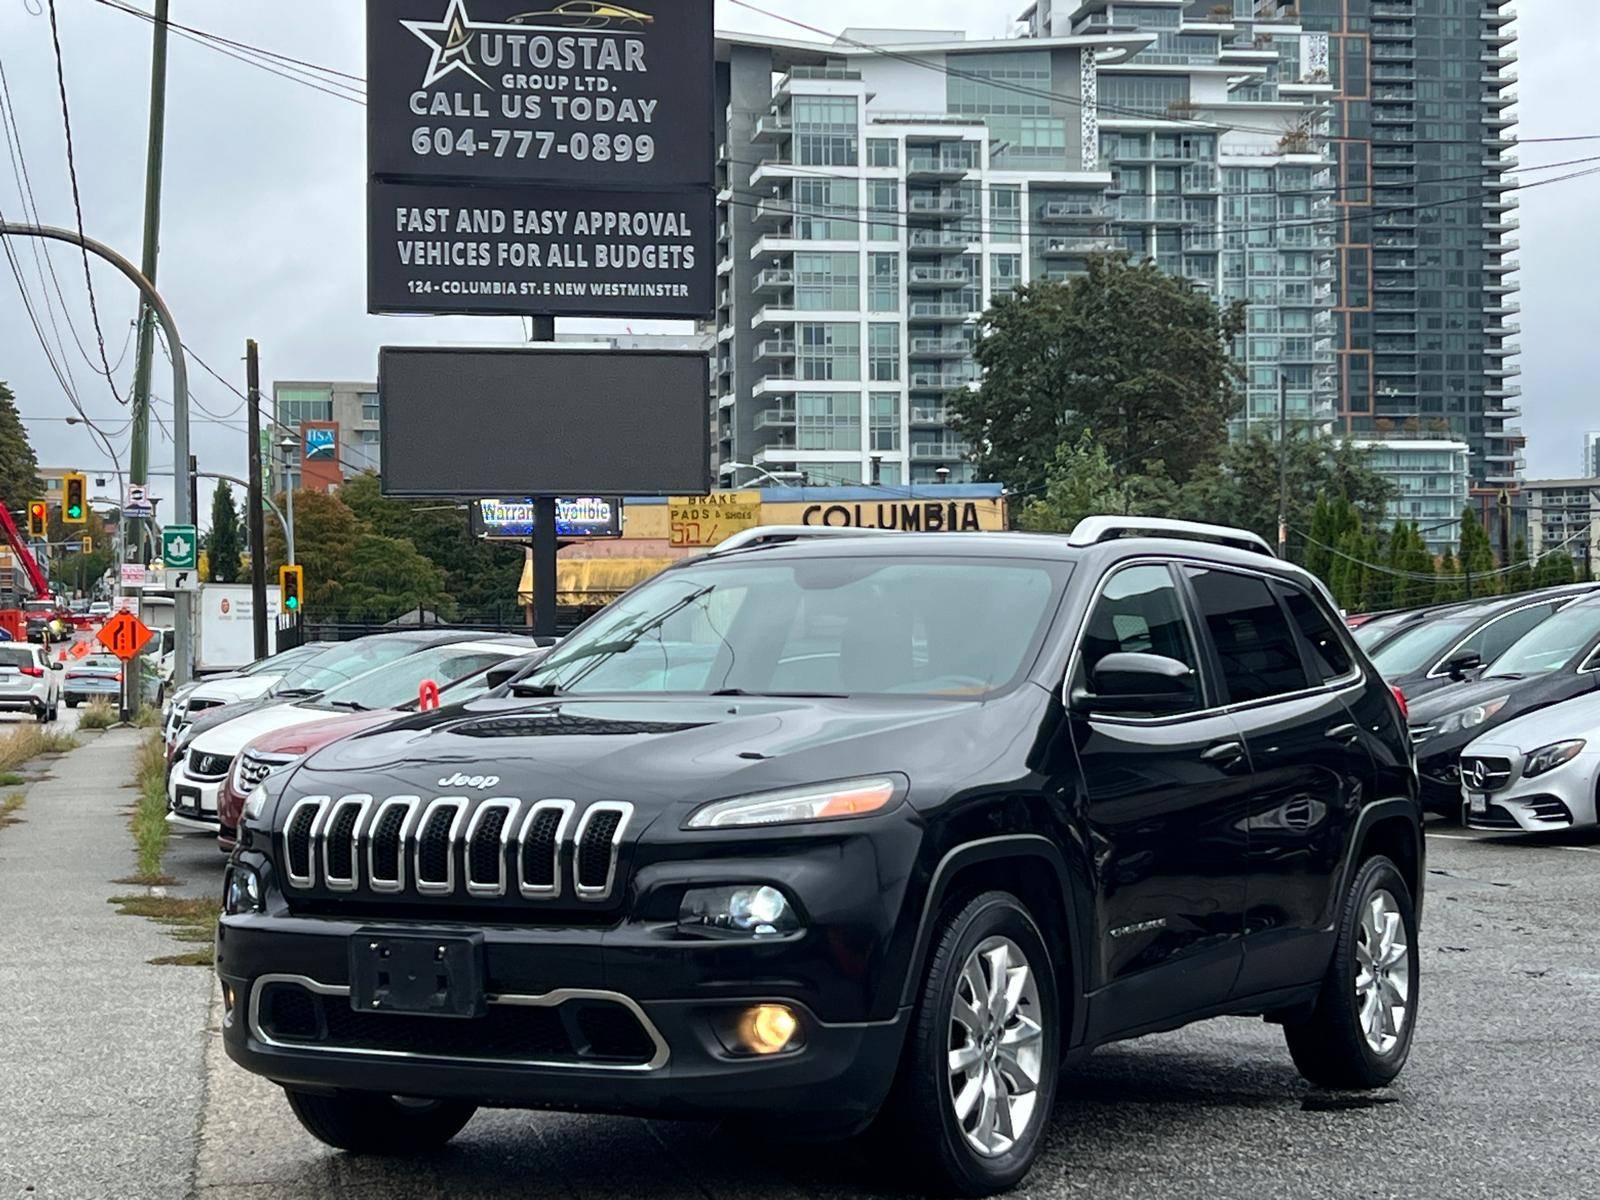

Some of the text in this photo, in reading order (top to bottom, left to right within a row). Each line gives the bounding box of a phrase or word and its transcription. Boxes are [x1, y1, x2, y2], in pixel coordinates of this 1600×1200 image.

[501, 73, 618, 93] GROUP LTD.
[409, 91, 658, 123] CALL US TODAY
[411, 126, 655, 163] 604-777-0899
[396, 208, 692, 237] FAST AND EASY APPROVAL
[397, 240, 695, 270] VEHICES FOR ALL BUDGETS
[553, 282, 587, 296] NEW
[590, 282, 689, 298] WESTMINSTER
[687, 493, 738, 505] BRAKE
[671, 509, 710, 521] PADS
[802, 502, 980, 532] COLUMBIA
[438, 772, 500, 789] Jeep
